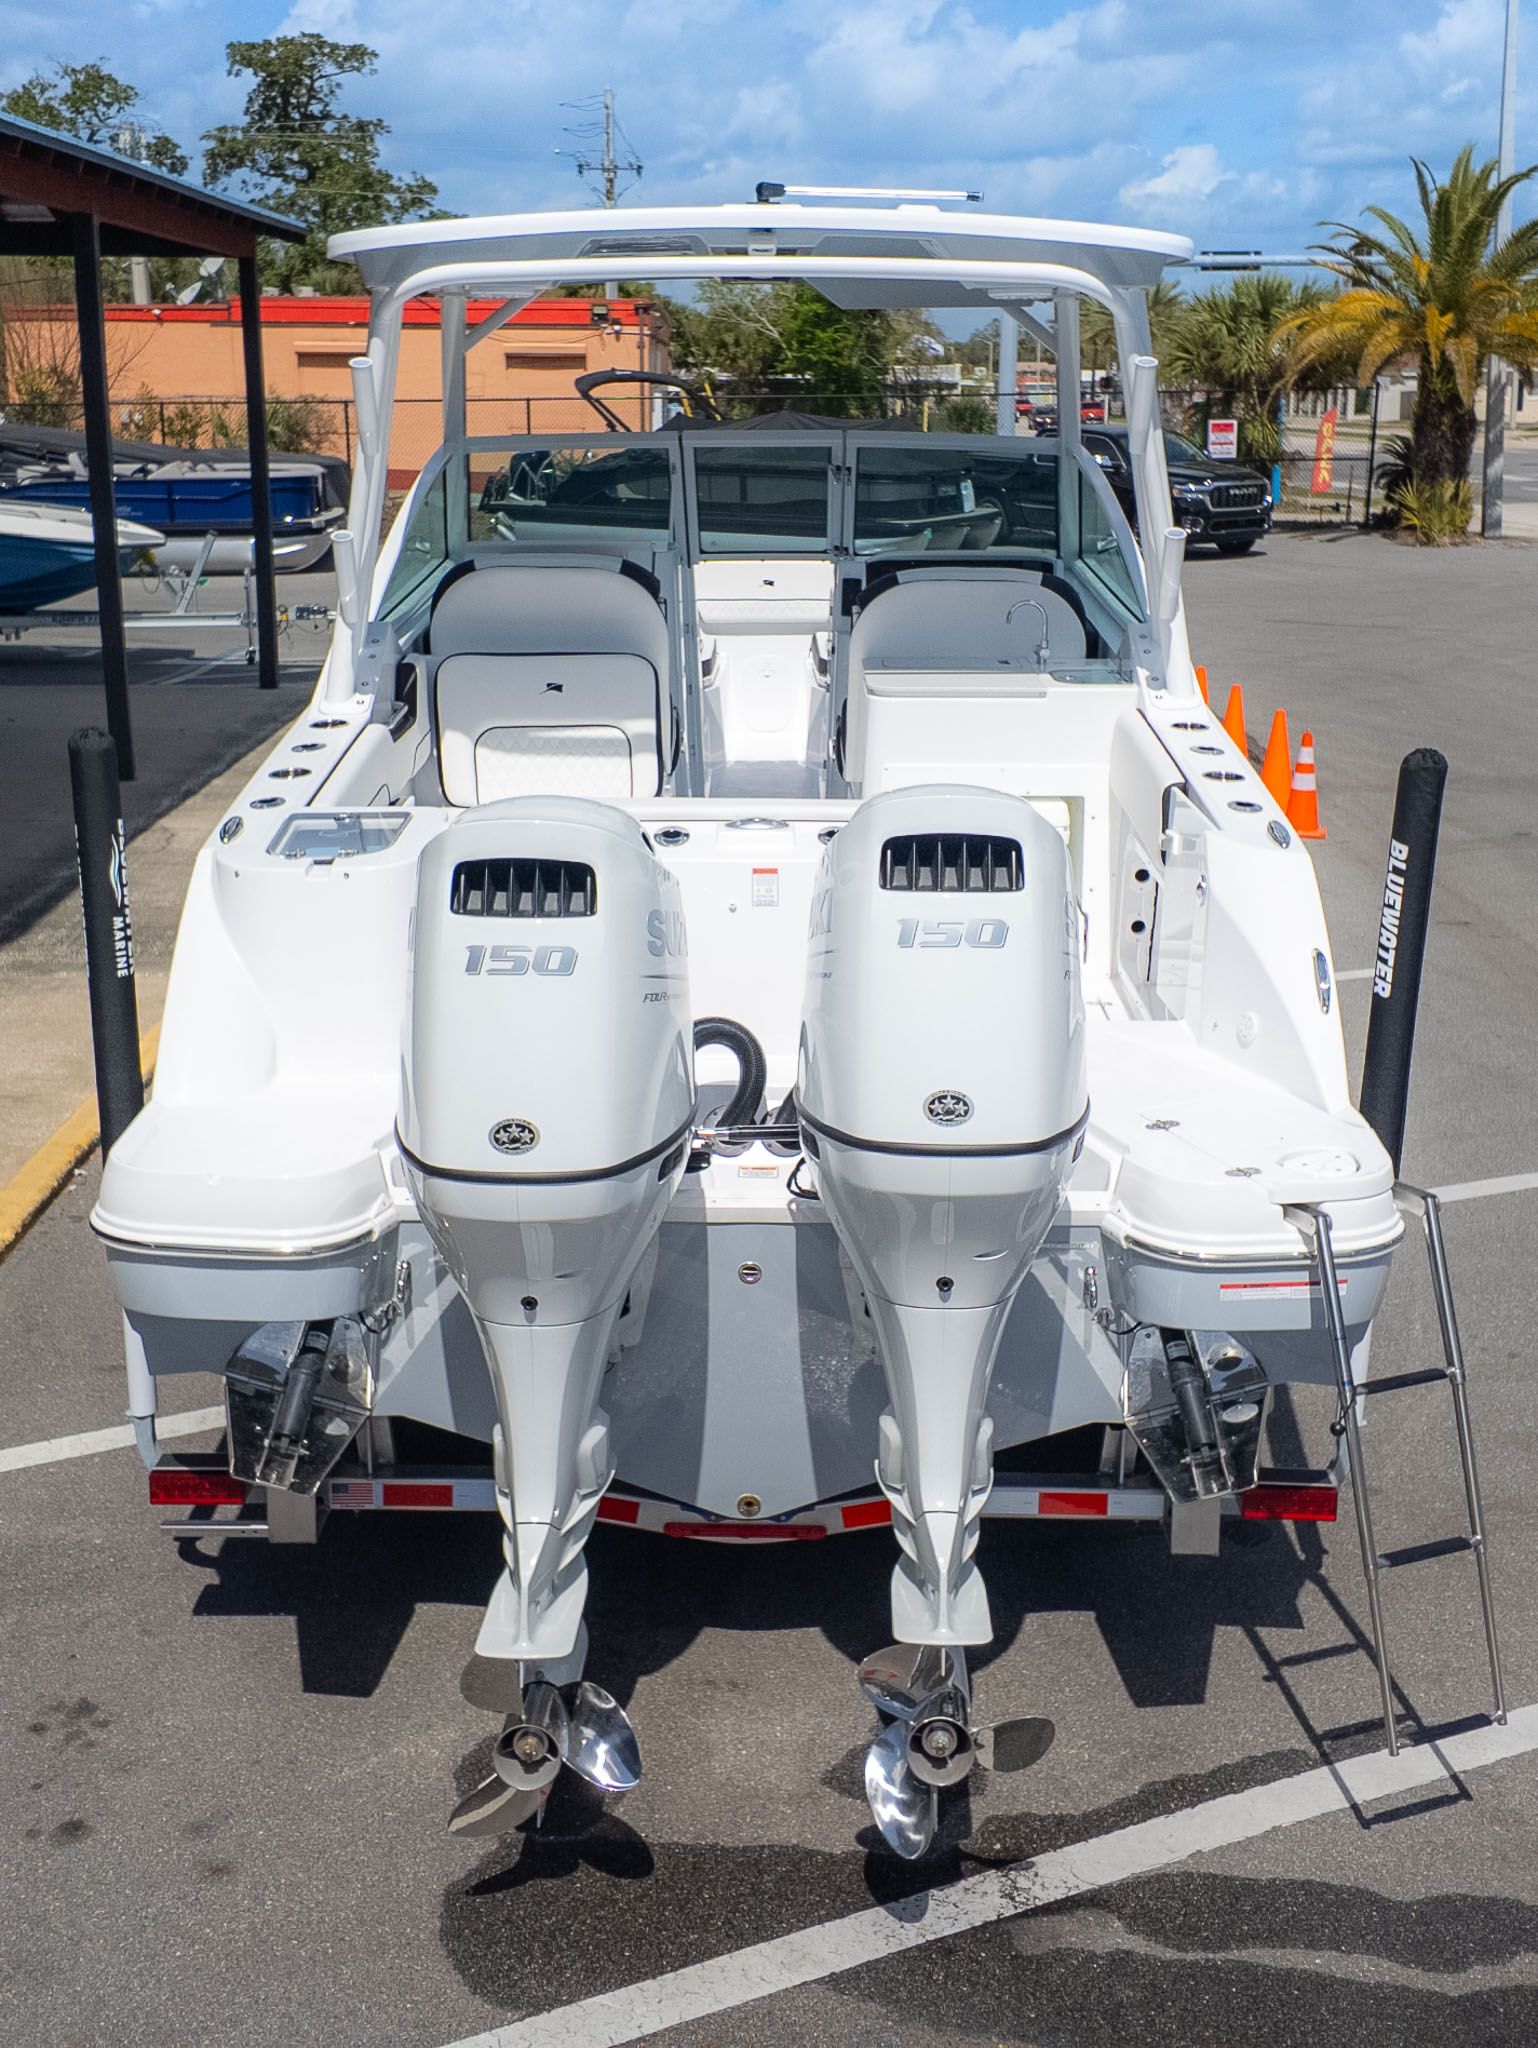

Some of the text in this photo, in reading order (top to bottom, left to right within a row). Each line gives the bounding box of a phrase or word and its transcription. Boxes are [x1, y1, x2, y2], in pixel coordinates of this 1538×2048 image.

[897, 918, 1010, 949] 150
[1373, 838, 1409, 999] BLUEWATER
[113, 916, 129, 978] MARINE
[464, 944, 578, 976] 150
